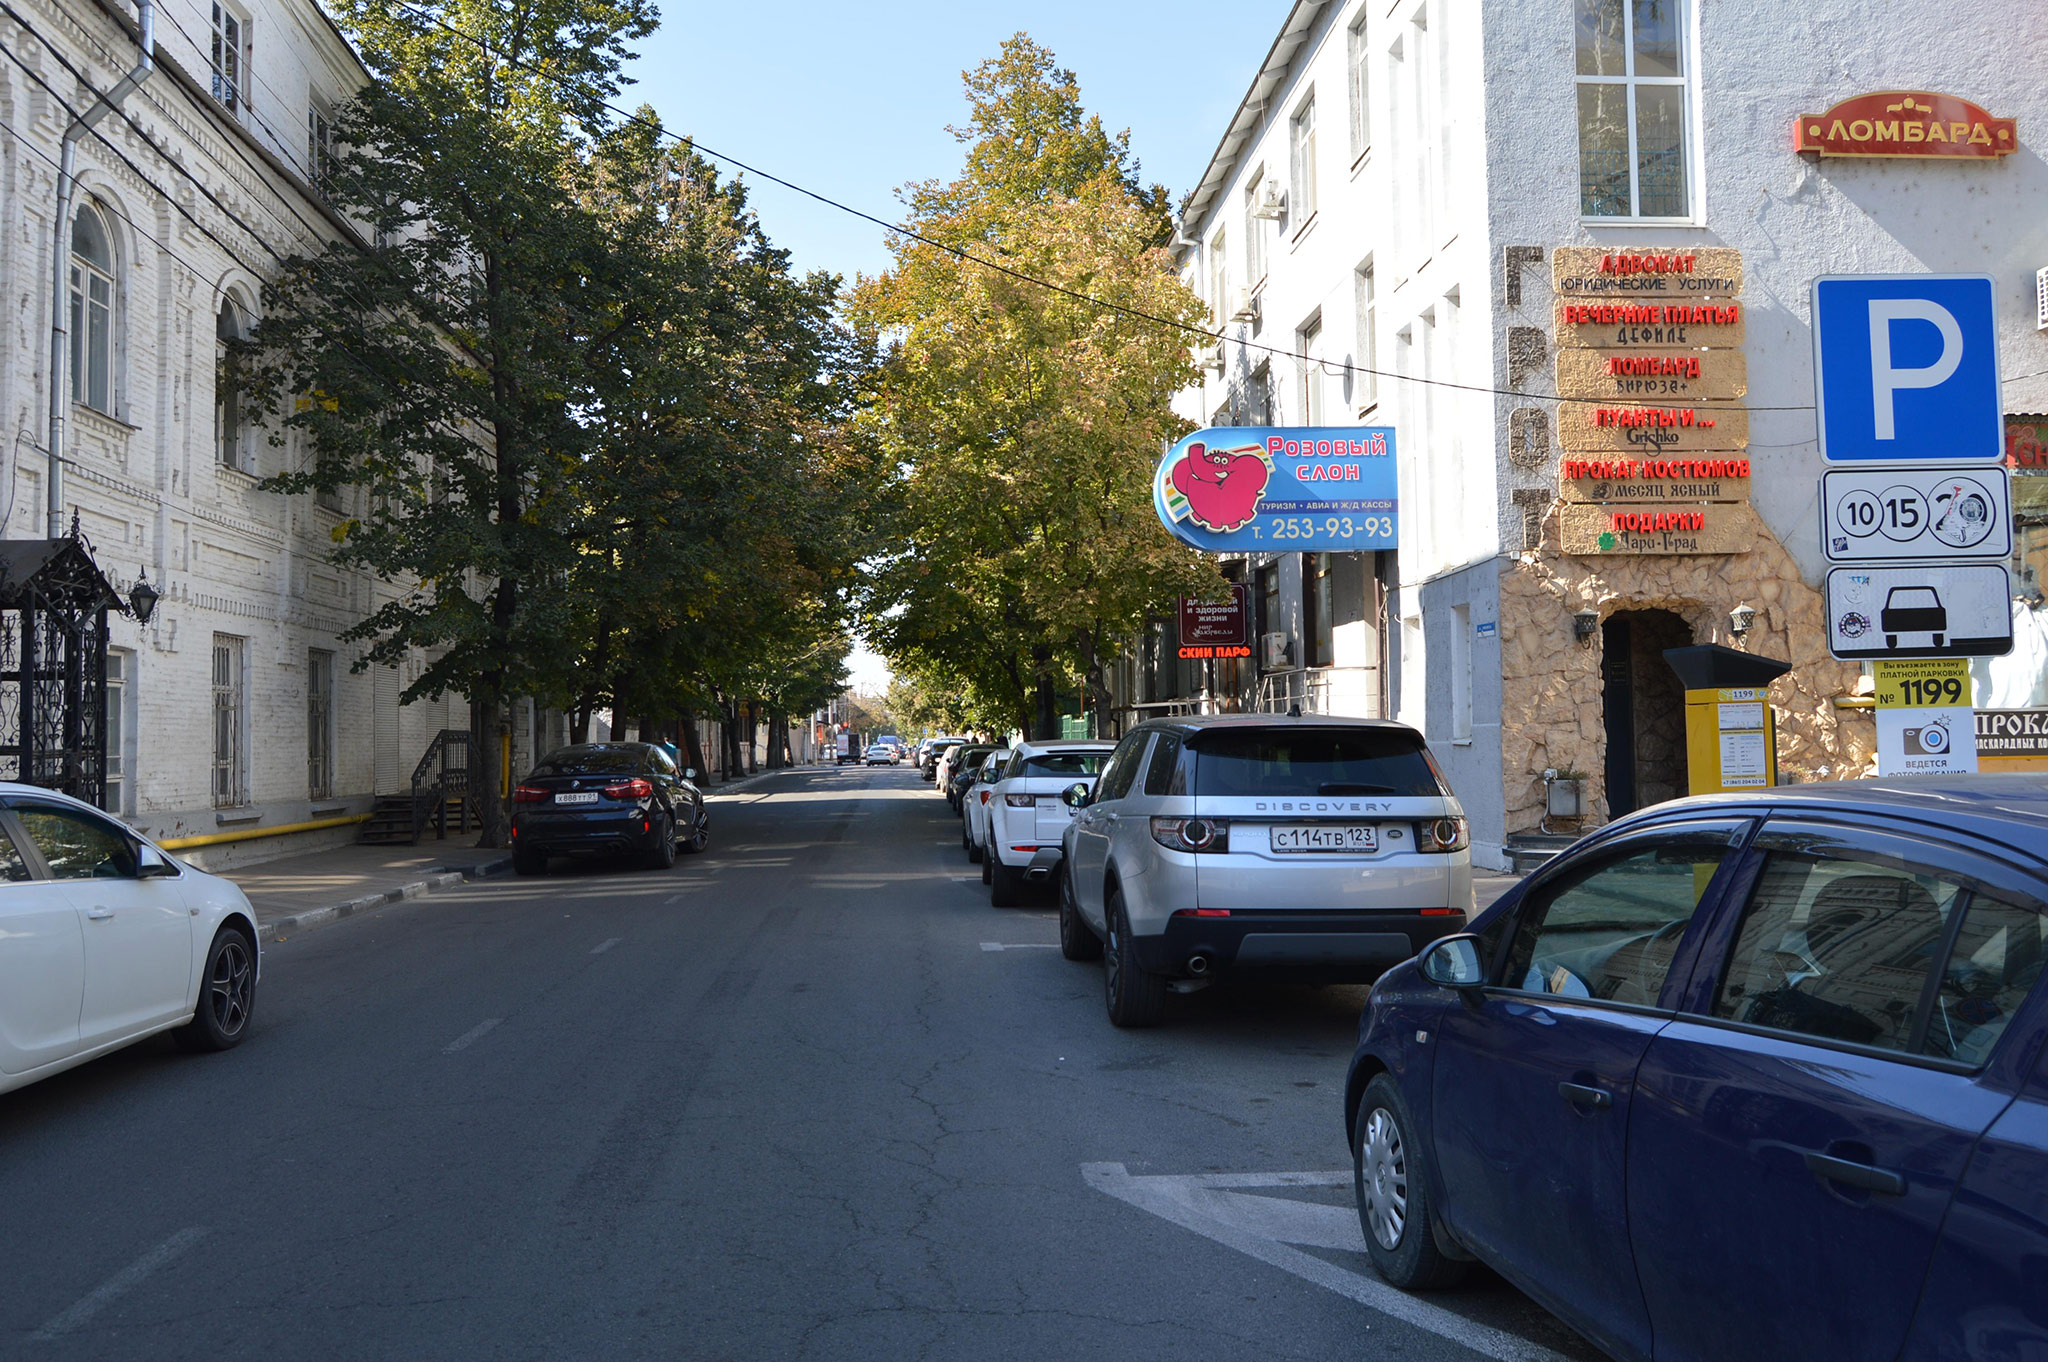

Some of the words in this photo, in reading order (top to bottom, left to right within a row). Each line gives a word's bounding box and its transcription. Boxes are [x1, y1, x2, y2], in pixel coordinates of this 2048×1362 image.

[1827, 120, 1993, 145] ЛОМБАРД
[1599, 255, 1697, 276] АДВОКАТ
[1560, 278, 1667, 291] ЮРИДИЧЕСКИЕ
[1678, 278, 1734, 291] УСЛУГИ
[1563, 305, 1661, 324] ВЕЧЕРНИЕ
[1664, 305, 1739, 323] ПЛАТЬЯ
[1617, 327, 1687, 345] ДЕФИЛЕ
[1607, 357, 1701, 379] ЛОМБАРД
[1595, 409, 1677, 427] ПУАНТЫ
[1680, 409, 1695, 426] И
[1626, 428, 1679, 457] Grishko
[1563, 460, 1639, 479] ПРОКАТ
[1642, 459, 1751, 479] КОСТЮМОВ
[1306, 502, 1330, 510] АВИА
[1340, 501, 1360, 510] Ж/Д
[1361, 501, 1392, 509] КАССЫ
[1847, 502, 1874, 526] 10
[1886, 498, 1919, 528] 15
[1272, 516, 1393, 539] 253-93-93
[1611, 512, 1705, 534] ПОДАРКИ
[1216, 646, 1251, 658] ПАРФ
[1880, 670, 1919, 679] ПЛАТНОЙ
[1921, 669, 1965, 678] ПАРКОВКИ
[1943, 661, 1960, 669] зону
[1733, 690, 1753, 698] 1199
[1899, 678, 1962, 705] 1199
[1905, 760, 1947, 769] ВЕДЕТСЯ
[1255, 803, 1393, 811] DISCOVERY
[1347, 828, 1371, 841] 123
